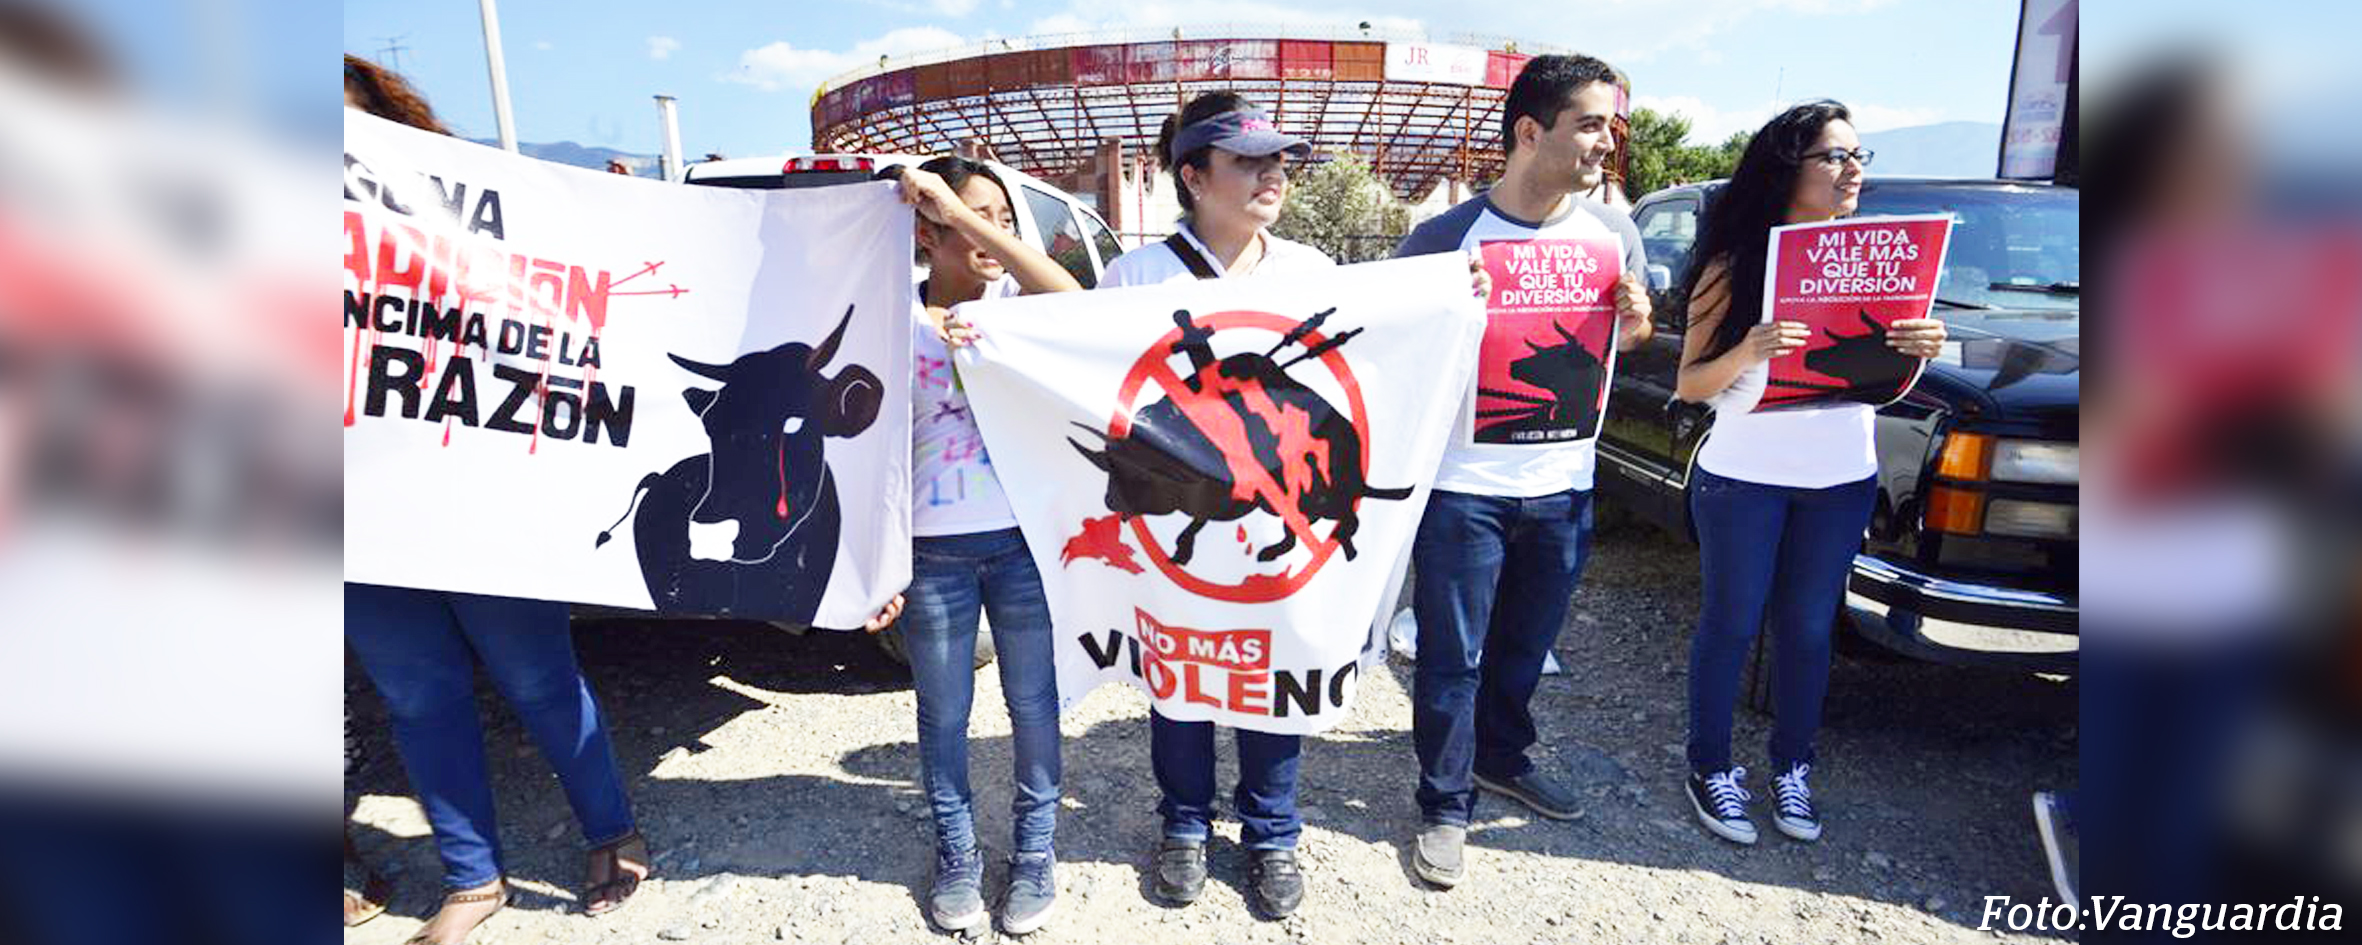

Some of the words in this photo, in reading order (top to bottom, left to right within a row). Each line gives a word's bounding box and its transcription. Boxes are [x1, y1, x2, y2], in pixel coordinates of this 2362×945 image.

[1404, 46, 1430, 66] JR
[1818, 232, 1845, 248] MI
[1854, 229, 1910, 247] VIDA
[1513, 245, 1537, 260] MI
[1545, 244, 1588, 260] VIDA
[1807, 246, 1862, 263] VALE
[1869, 243, 1919, 262] MÁS
[1506, 258, 1551, 275] VALE
[1822, 262, 1869, 279] QUE
[1876, 261, 1901, 277] TU
[1519, 274, 1559, 290] QUE
[1563, 273, 1584, 289] TU
[1800, 275, 1917, 294] DIVERSIÓN
[497, 318, 554, 361] DE
[558, 331, 602, 369] LA
[1138, 615, 1177, 655] NO
[1188, 633, 1262, 664] MÁS
